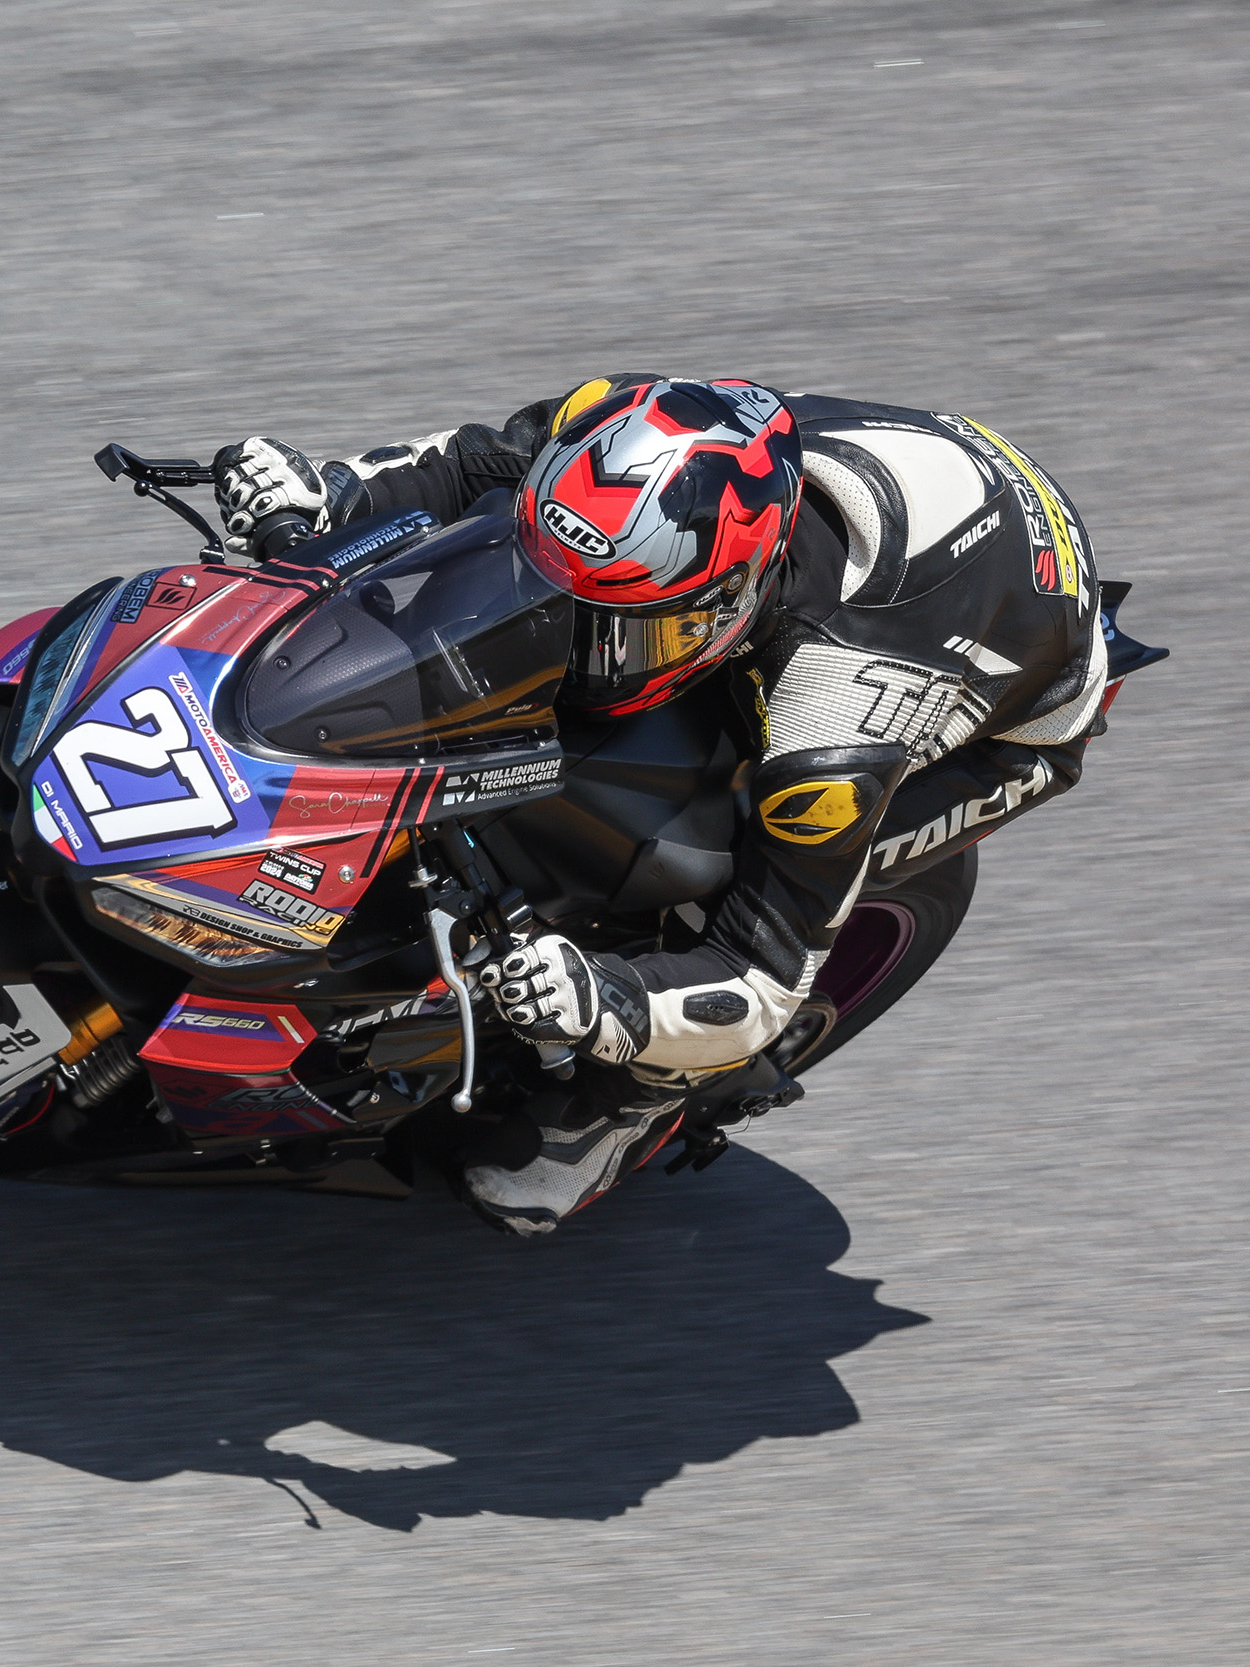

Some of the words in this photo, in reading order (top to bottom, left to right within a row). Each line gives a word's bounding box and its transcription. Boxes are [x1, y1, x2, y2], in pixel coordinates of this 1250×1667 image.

[544, 506, 607, 554] HJC
[950, 510, 1000, 559] TAICHI
[331, 529, 403, 569] MILLENNIUM
[504, 704, 533, 716] Puig
[49, 686, 238, 853] 27
[479, 769, 559, 792] TECHNOLOGIES
[480, 758, 562, 783] MILLENNIUM
[477, 790, 507, 801] Advanced
[529, 781, 557, 793] Solutions
[41, 780, 54, 798] DI
[51, 800, 84, 850] MARIO
[259, 863, 283, 878] 2024
[269, 851, 299, 870] TWINS
[299, 863, 322, 877] CUP
[200, 911, 231, 927] DESIGN
[230, 923, 253, 936] SHOP
[260, 932, 304, 948] GRAPHICS
[171, 1011, 266, 1031] RS660
